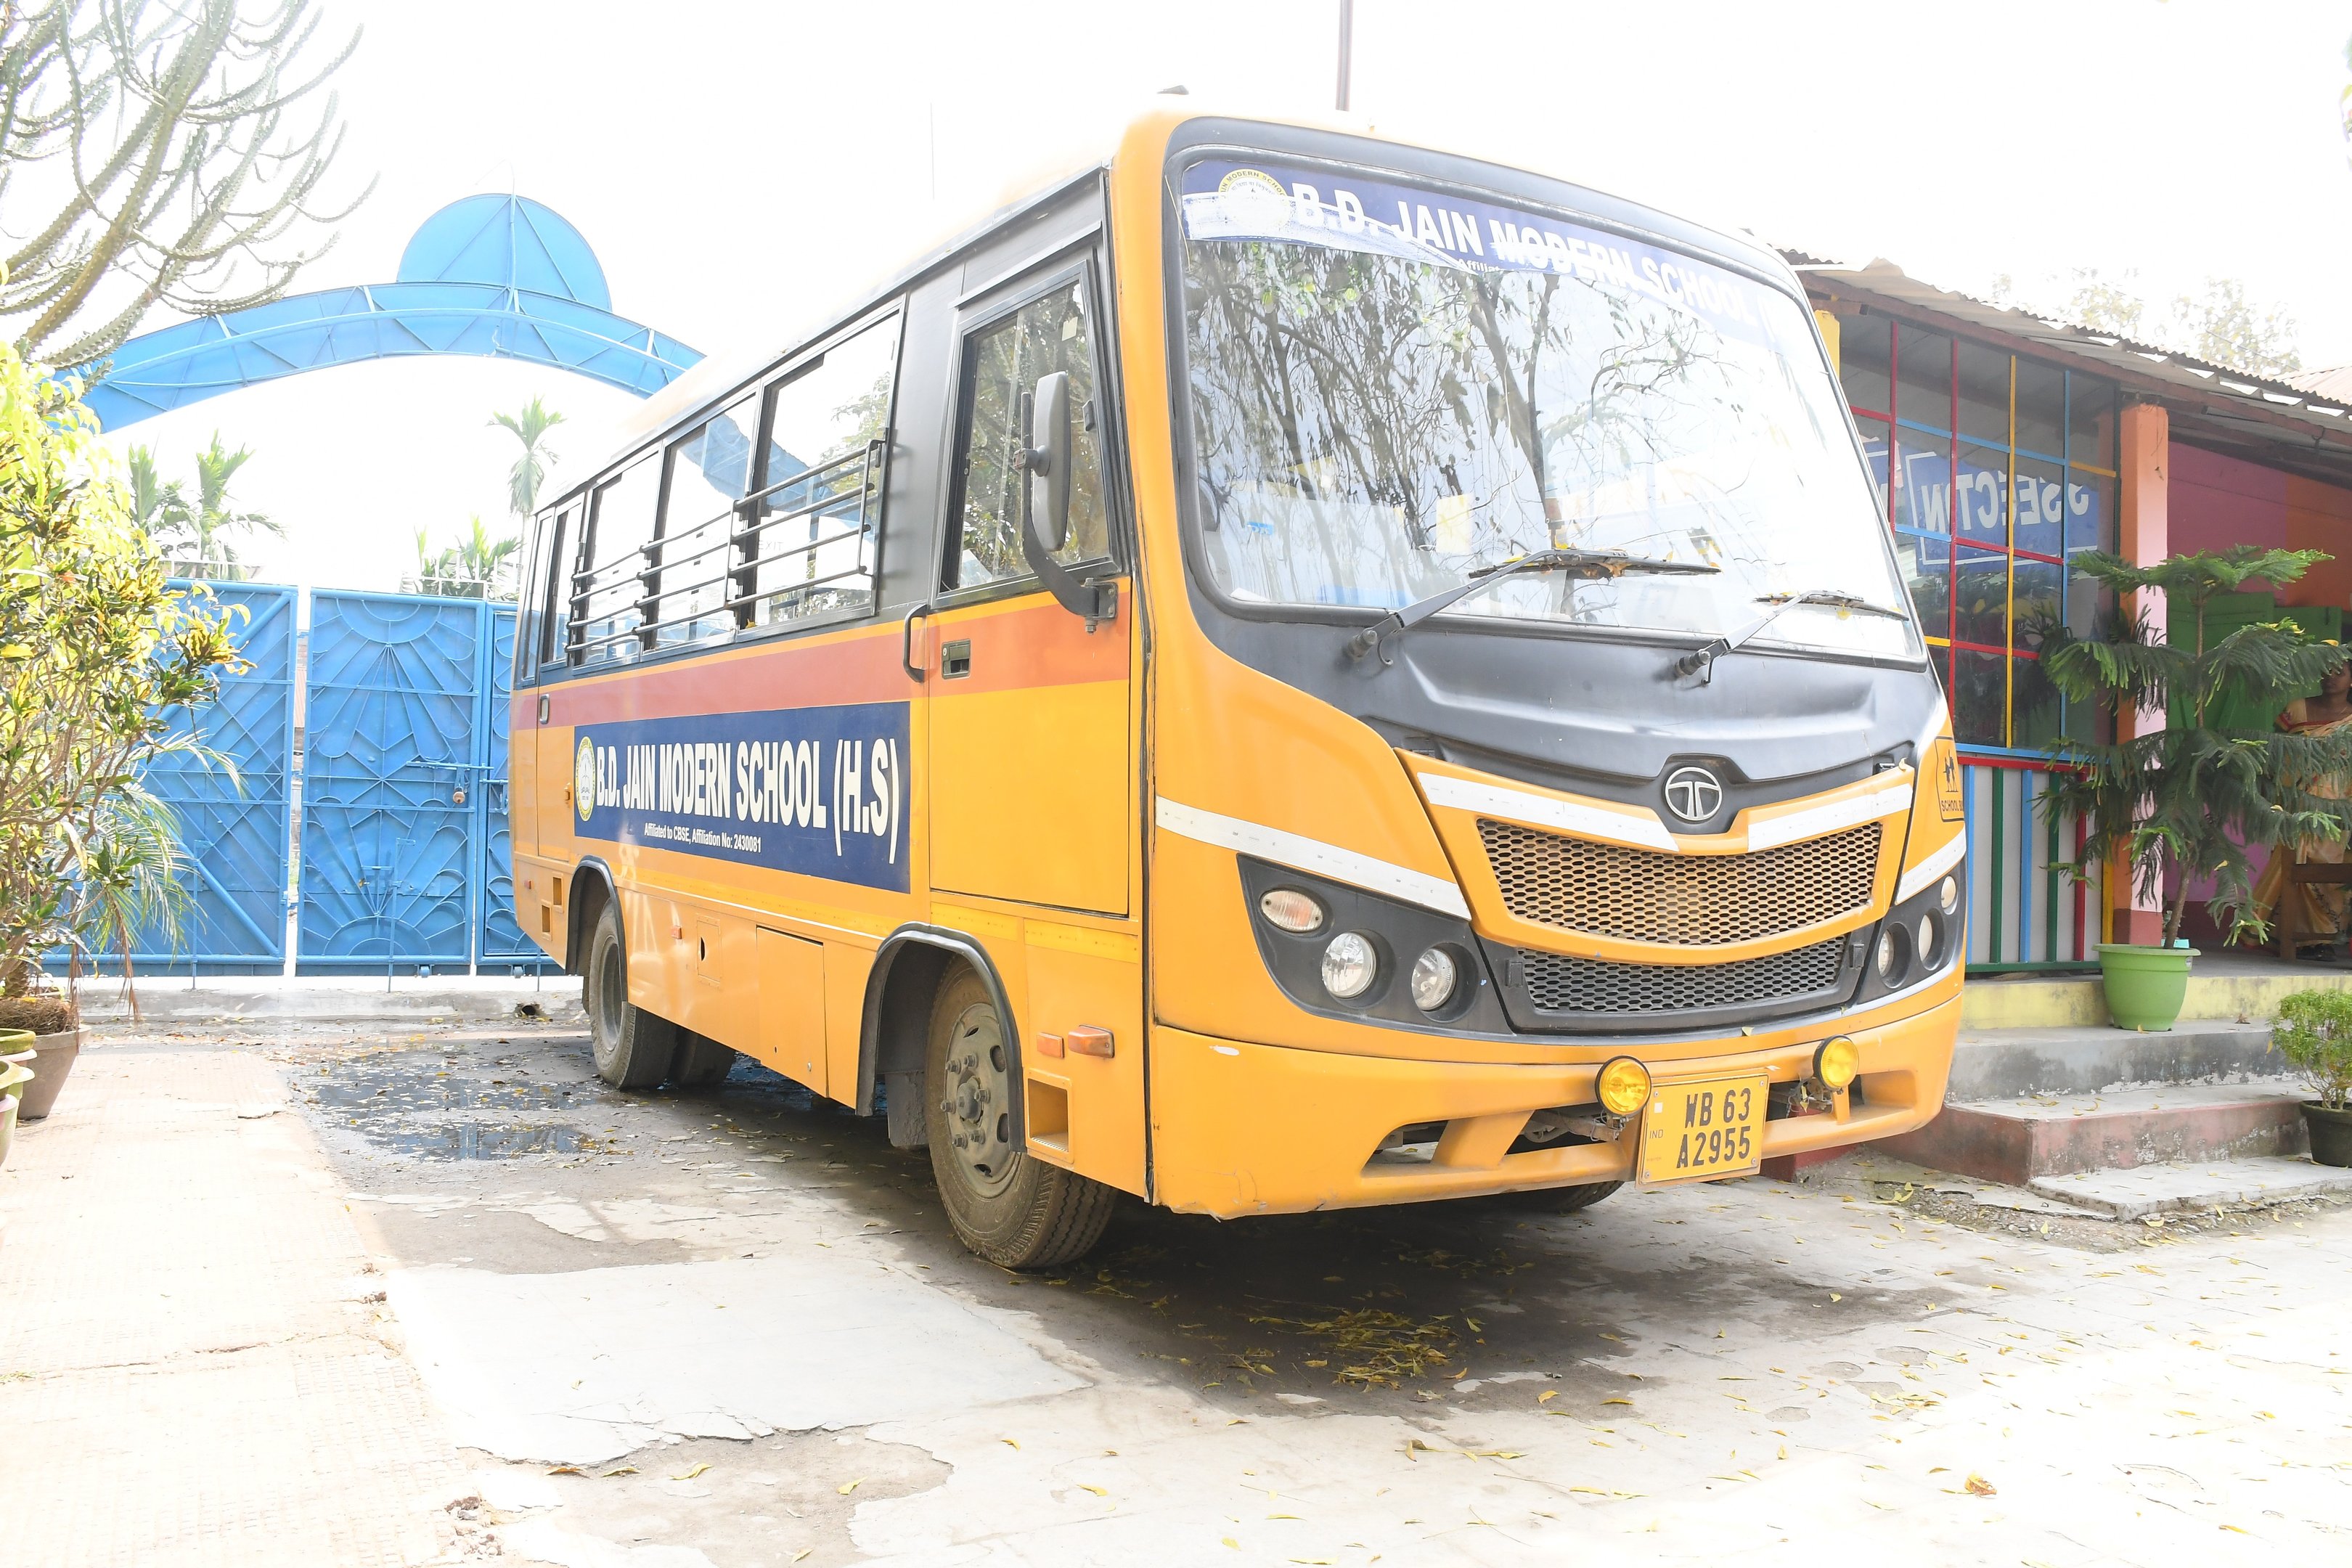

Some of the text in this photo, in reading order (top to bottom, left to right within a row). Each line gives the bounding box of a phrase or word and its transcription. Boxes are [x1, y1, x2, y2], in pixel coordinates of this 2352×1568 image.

[1226, 171, 1259, 181] MODERN
[1390, 200, 1485, 256] JAIN
[1488, 219, 1641, 291] MODERN
[1641, 257, 1757, 327] SCHOOL
[596, 746, 620, 807] B.D.
[623, 744, 656, 811] JAIN
[659, 742, 731, 819] MODERN
[736, 740, 827, 829] SCHOOL
[833, 738, 899, 865] (H.S)
[644, 822, 761, 853] Affiliated to CBSE, Affiliation No: 2430081
[1684, 1087, 1752, 1129] WB 63
[1649, 1129, 1664, 1139] IND
[1676, 1125, 1751, 1169] A2955
